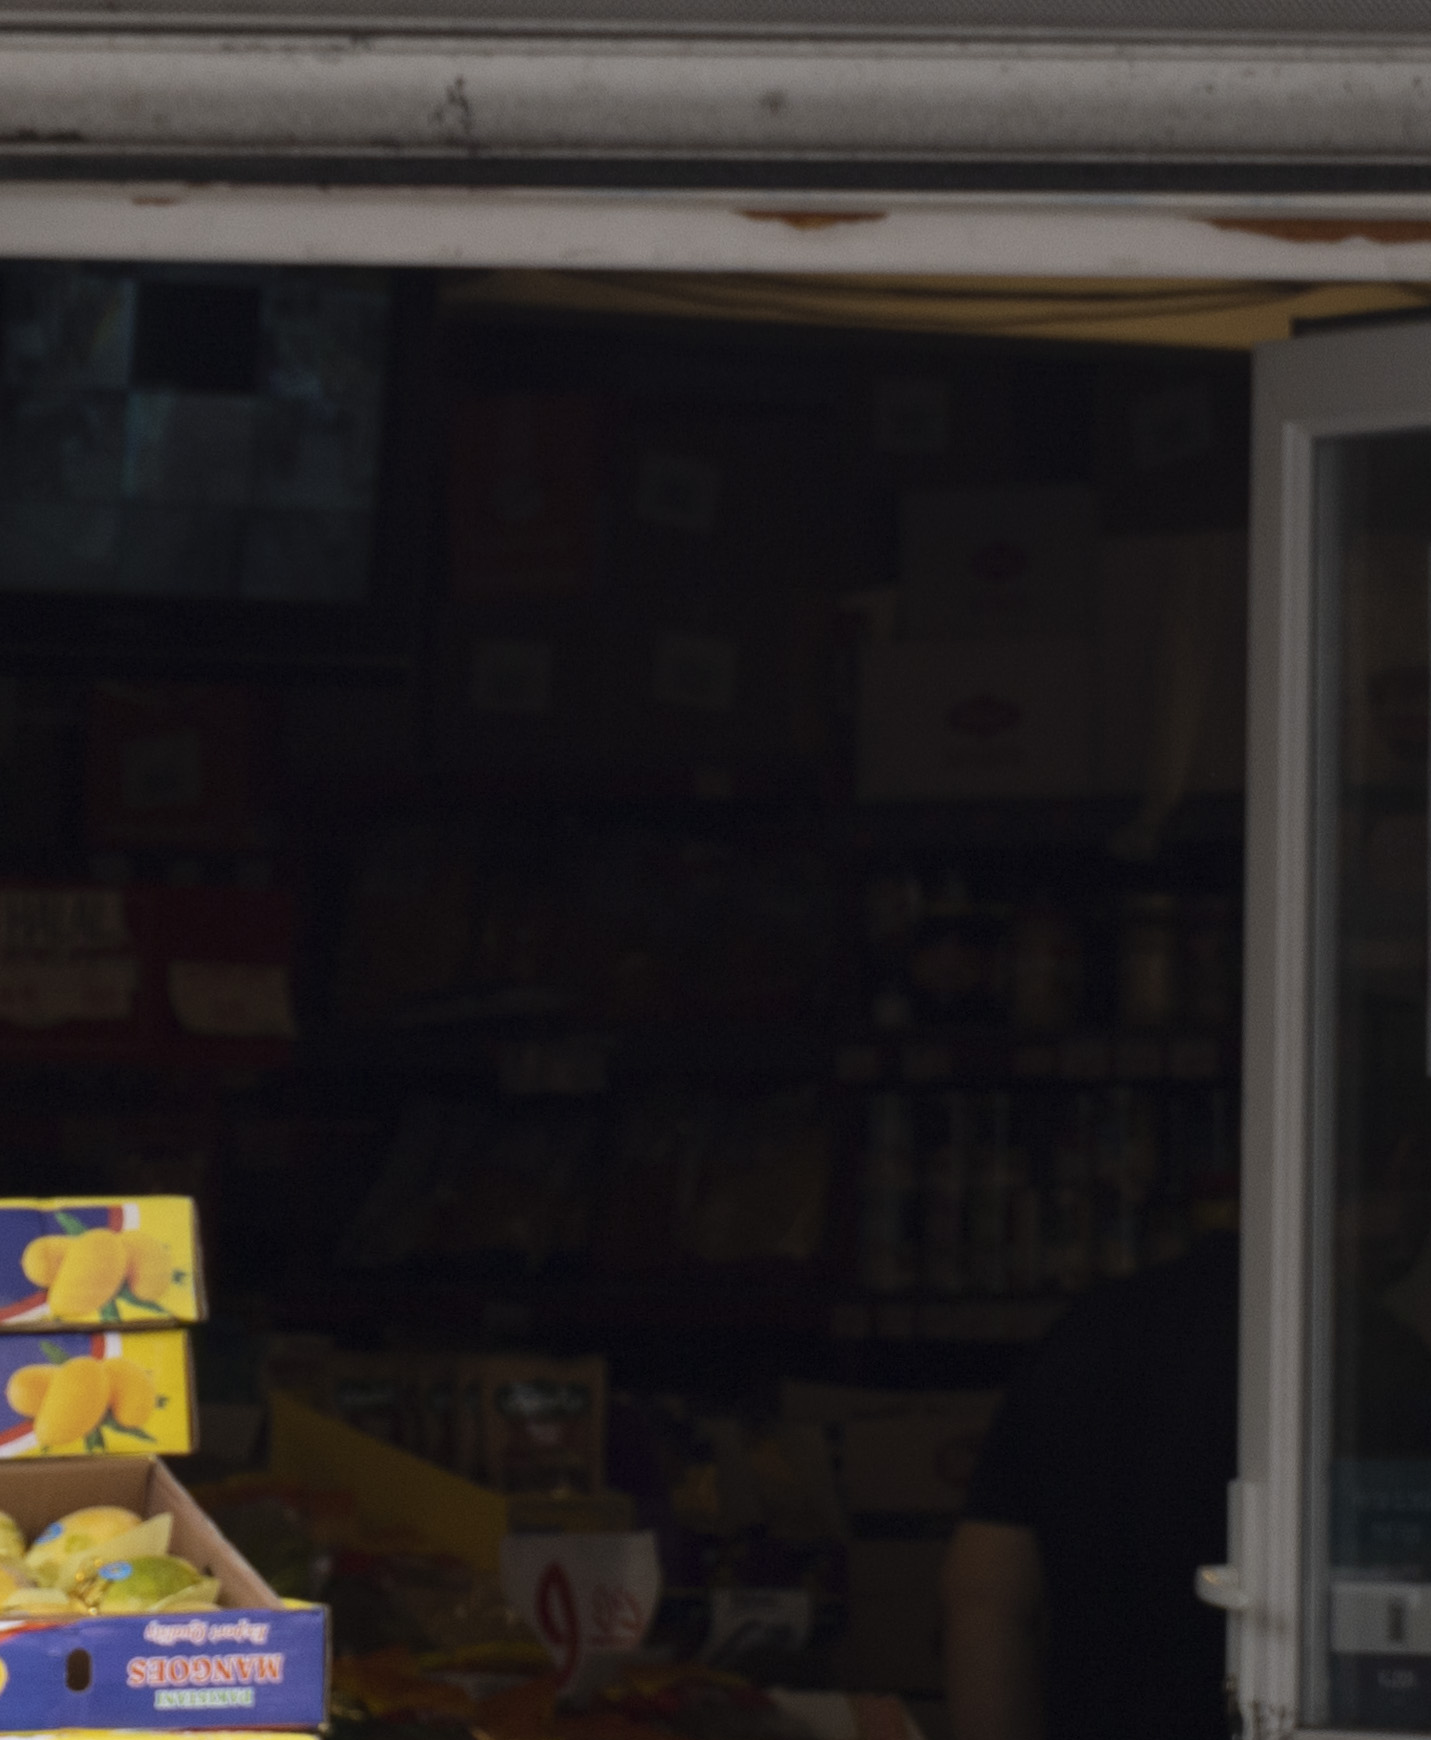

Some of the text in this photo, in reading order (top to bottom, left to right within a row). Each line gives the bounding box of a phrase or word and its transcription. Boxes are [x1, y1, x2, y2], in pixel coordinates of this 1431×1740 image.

[144, 1622, 269, 1644] Export Quality
[126, 1653, 283, 1686] MANGOES
